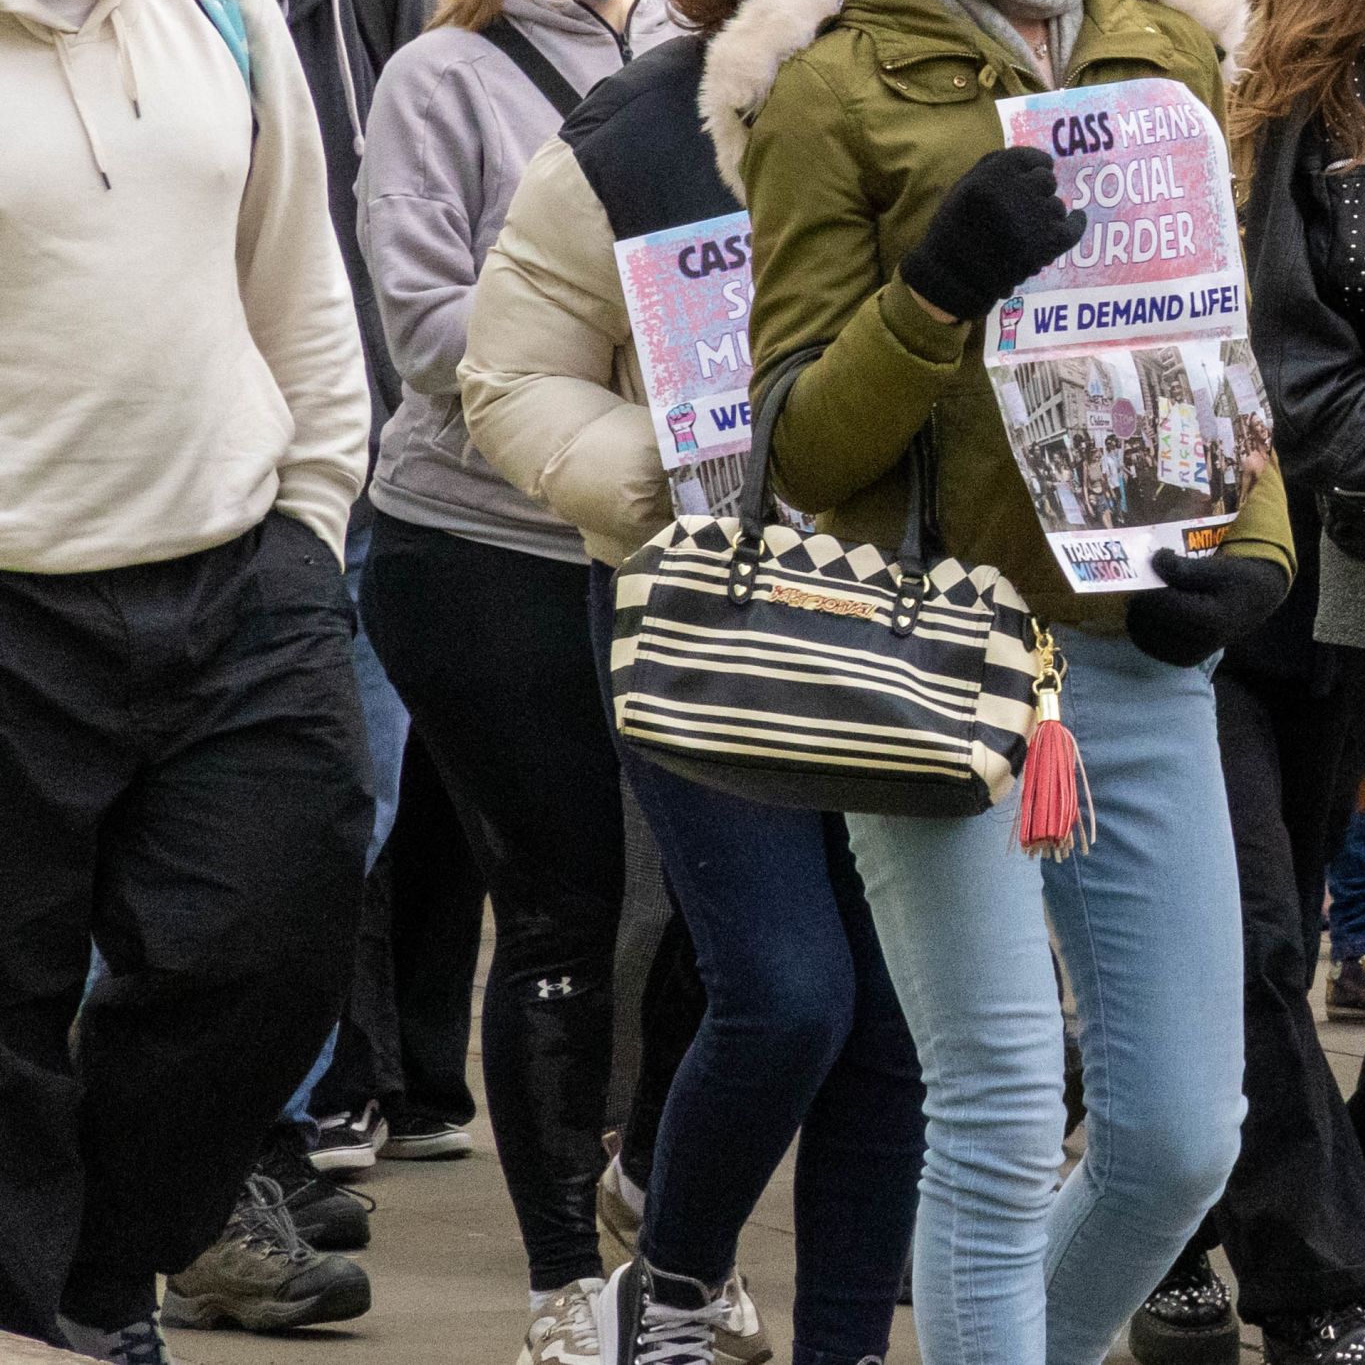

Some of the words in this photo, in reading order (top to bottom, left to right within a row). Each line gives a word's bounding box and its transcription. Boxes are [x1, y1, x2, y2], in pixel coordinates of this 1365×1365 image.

[1052, 111, 1114, 157] CASS
[1116, 104, 1201, 148] MEANS
[1071, 154, 1186, 211] SOCIAL
[1057, 210, 1196, 270] URDER
[1033, 304, 1069, 334] WE
[1077, 294, 1184, 330] DEMAND
[1190, 285, 1239, 319] LIFE!
[1064, 541, 1112, 563] TRANS
[1071, 560, 1138, 582] MISSION
